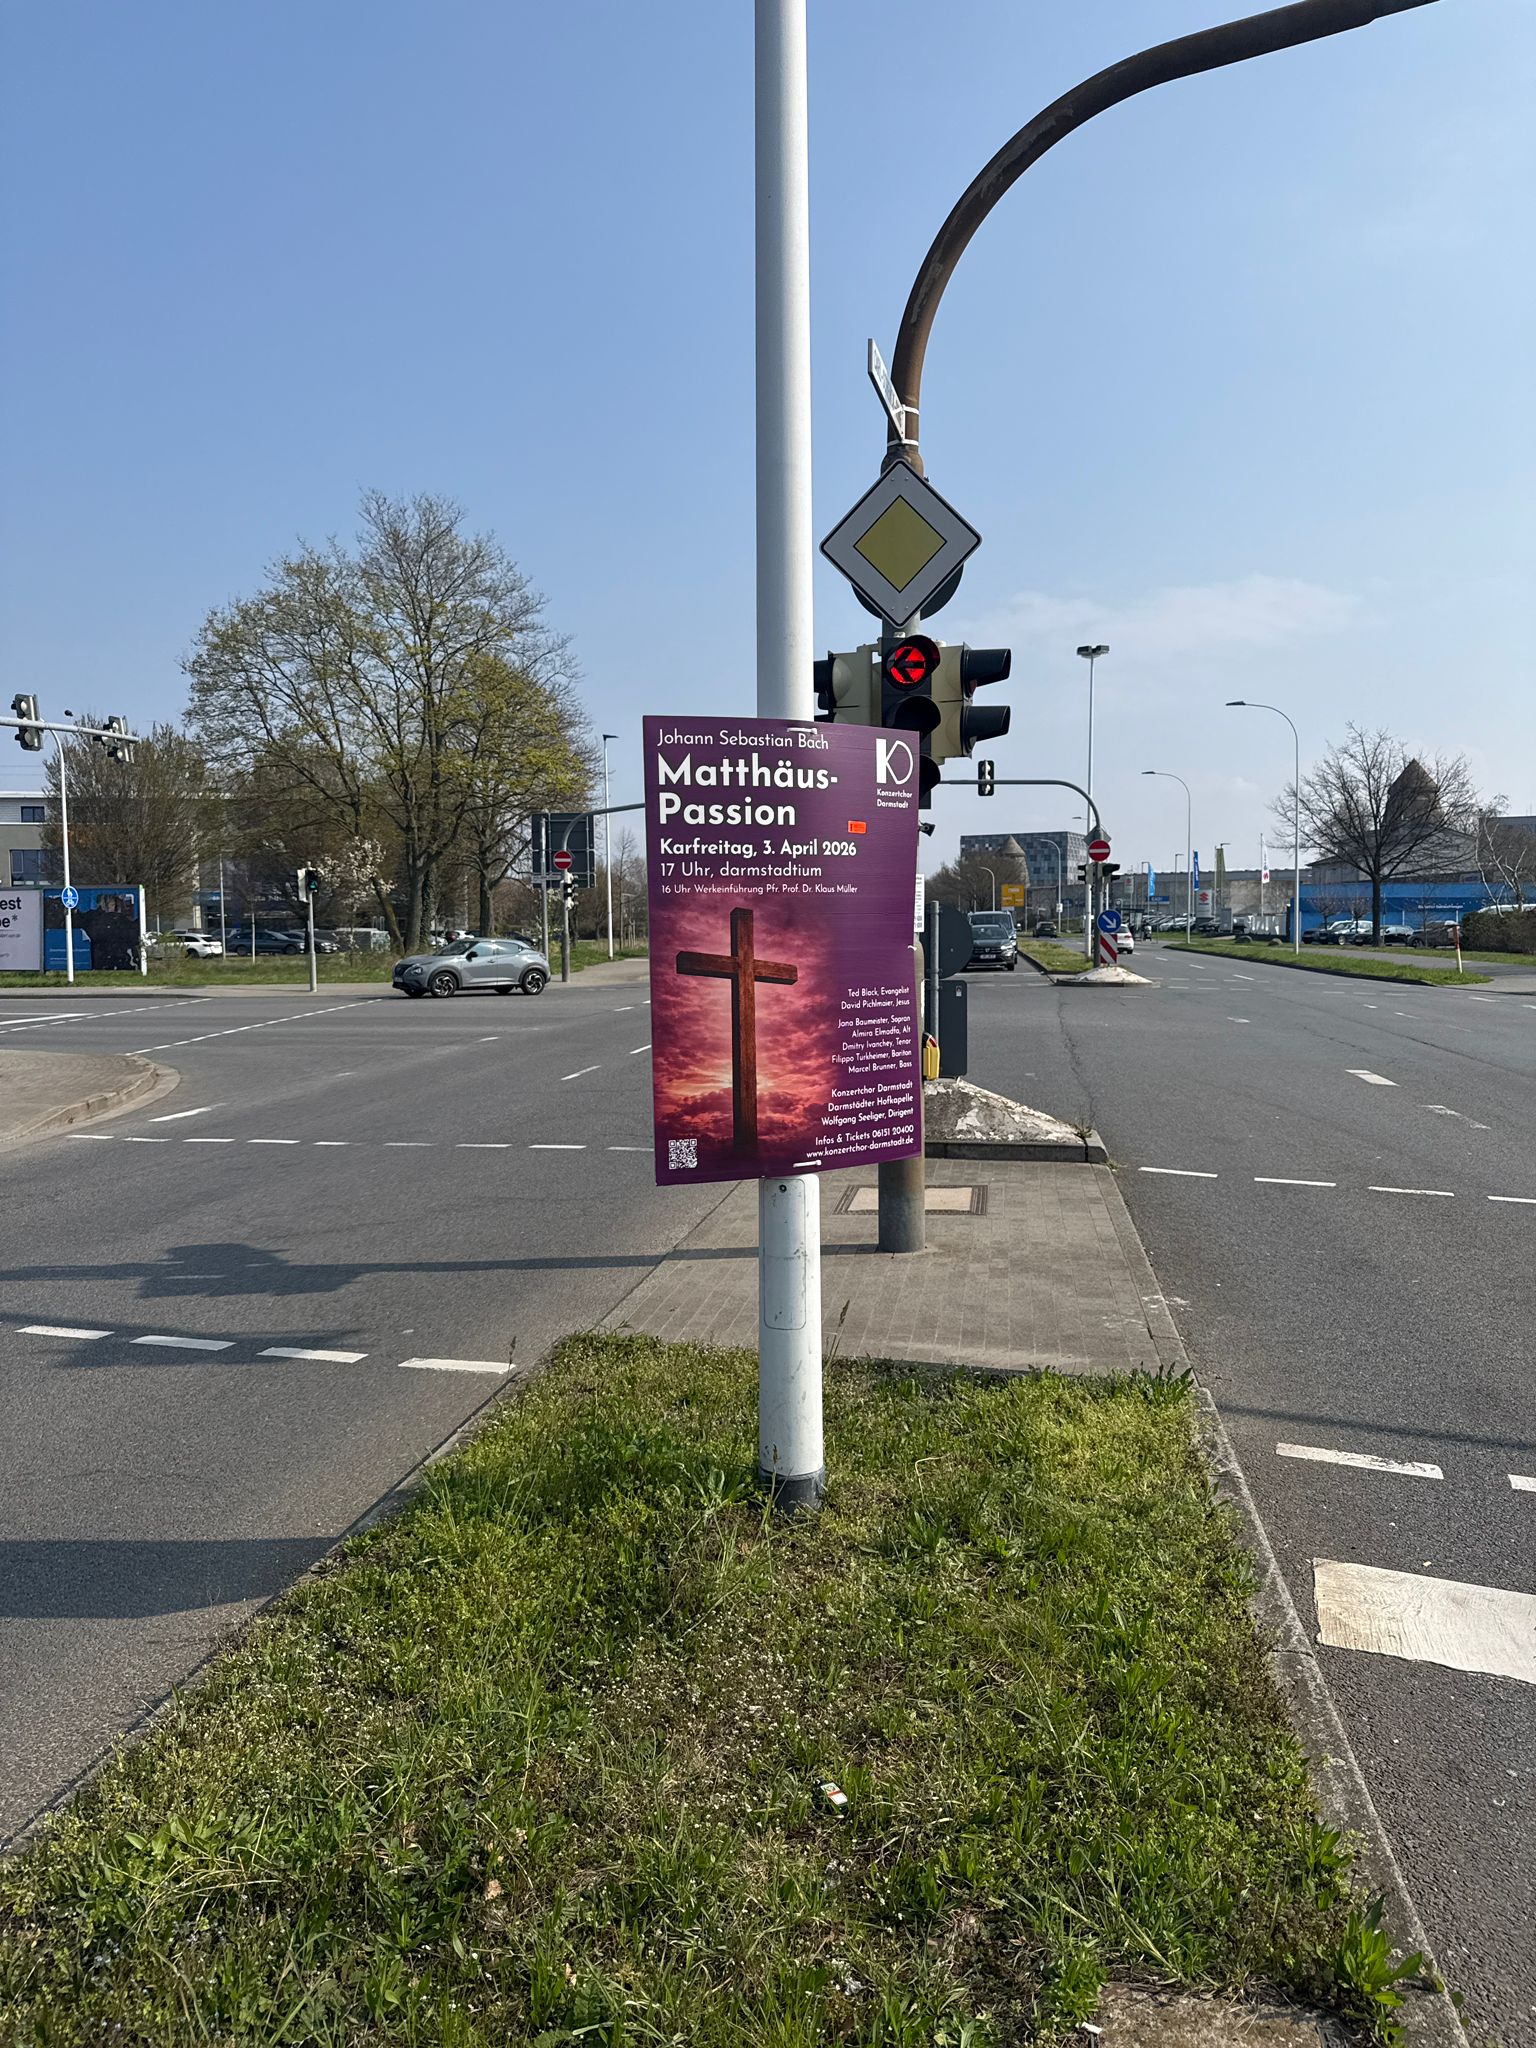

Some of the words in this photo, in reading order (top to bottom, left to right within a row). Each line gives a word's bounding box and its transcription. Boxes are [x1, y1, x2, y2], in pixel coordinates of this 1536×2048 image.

[657, 728, 714, 747] Johann
[719, 730, 793, 748] Sebastian
[798, 733, 829, 750] Bach
[658, 752, 838, 790] Matthäus-
[876, 788, 913, 799] Konzertchor
[659, 792, 796, 826] Passion
[876, 799, 909, 808] Darmstadt
[660, 838, 758, 859] Karfreitag,
[763, 841, 776, 855] 3.
[780, 839, 818, 859] April
[822, 841, 857, 856] 2026
[660, 863, 675, 877] 17
[682, 863, 714, 878] Uhr,
[720, 861, 822, 877] darmstadtium
[662, 885, 671, 893] 16
[674, 885, 691, 893] Uhr
[694, 884, 764, 895] Werkeinführung
[766, 884, 780, 893] Pfr.
[782, 884, 800, 893] Prof.
[802, 884, 813, 893] Dr.
[815, 884, 835, 893] Klaus
[837, 885, 858, 893] Müller
[848, 988, 860, 997] Ted
[862, 987, 879, 998] Black,
[880, 986, 910, 997] Evangelist
[841, 1000, 861, 1010] David
[862, 998, 894, 1009] Pichlmaier,
[896, 998, 910, 1006] Jesus
[838, 1018, 854, 1028] Jana
[855, 1016, 889, 1027] Baumeister,
[890, 1014, 911, 1025] Sopran
[852, 1029, 873, 1038] Almira
[902, 1025, 911, 1034] Alt
[842, 1041, 864, 1051] Dmitry
[895, 1038, 912, 1046] Tenor
[831, 1054, 854, 1064] Filippo
[891, 1048, 912, 1058] Bariton
[848, 1064, 871, 1074] Marcel
[873, 1063, 897, 1072] Brunner,
[899, 1060, 912, 1069] Bass
[831, 1085, 876, 1098] Konzertchor
[878, 1080, 913, 1093] Darmstadt
[828, 1100, 875, 1112] Darmstädter
[876, 1093, 914, 1106] Hofkapelle
[821, 1114, 857, 1127] Wolfgang
[858, 1111, 887, 1122] Seeliger,
[887, 1107, 914, 1118] Dirigent
[815, 1135, 835, 1146] Infos
[837, 1133, 843, 1143] &
[845, 1130, 870, 1142] Tickets
[872, 1126, 890, 1138] 06151
[892, 1124, 914, 1136] 20400
[806, 1135, 914, 1159] www.konzertchor-darmstadt.de
